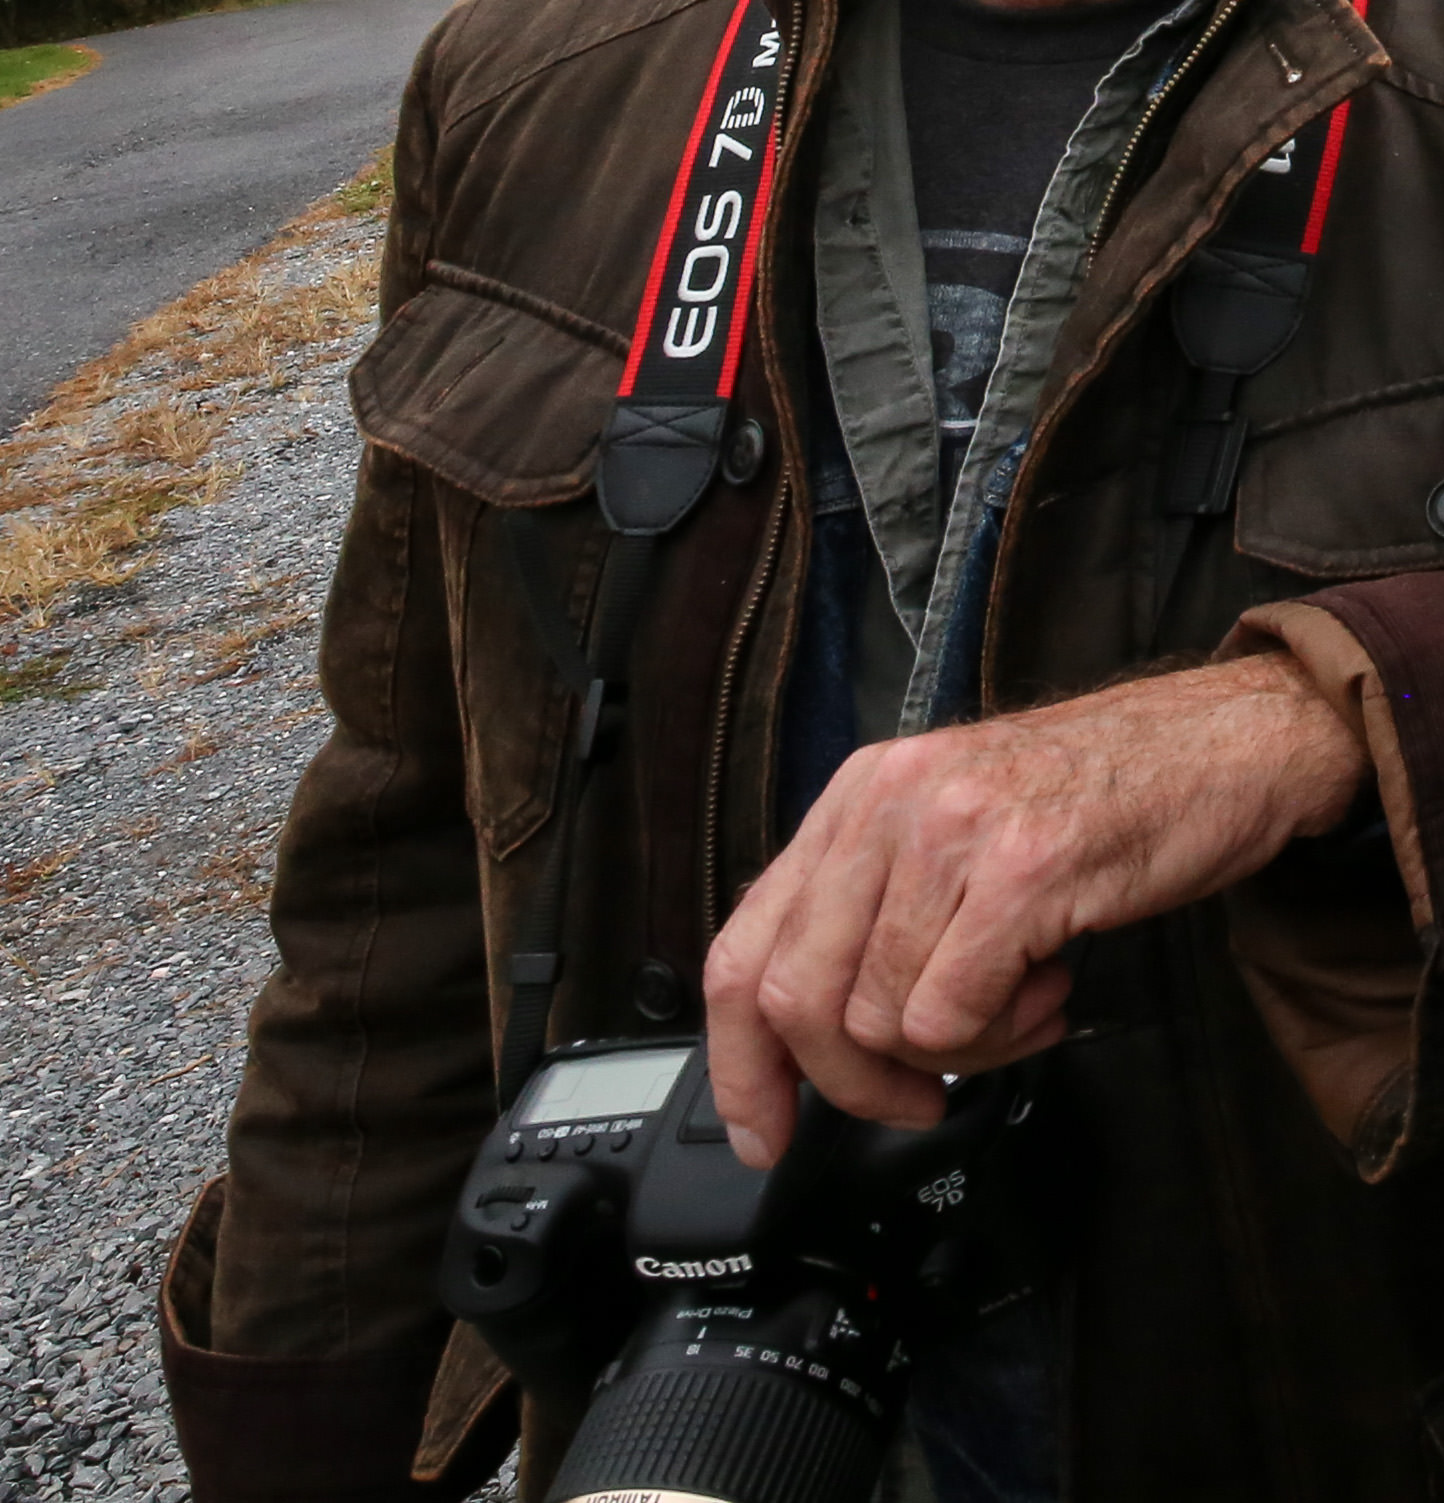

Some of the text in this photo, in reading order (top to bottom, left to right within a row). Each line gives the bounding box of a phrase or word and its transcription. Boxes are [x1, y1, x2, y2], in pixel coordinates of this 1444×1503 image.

[664, 189, 743, 358] EOS
[709, 86, 764, 169] 7D
[917, 1169, 966, 1204] EOS
[931, 1188, 964, 1212] 7D
[635, 1253, 753, 1280] Canon
[676, 1306, 754, 1320] Piezo Drive
[686, 1343, 701, 1356] 18
[734, 1345, 755, 1359] 35
[760, 1349, 780, 1363] 50
[785, 1355, 804, 1369] 70
[809, 1363, 830, 1380] 100
